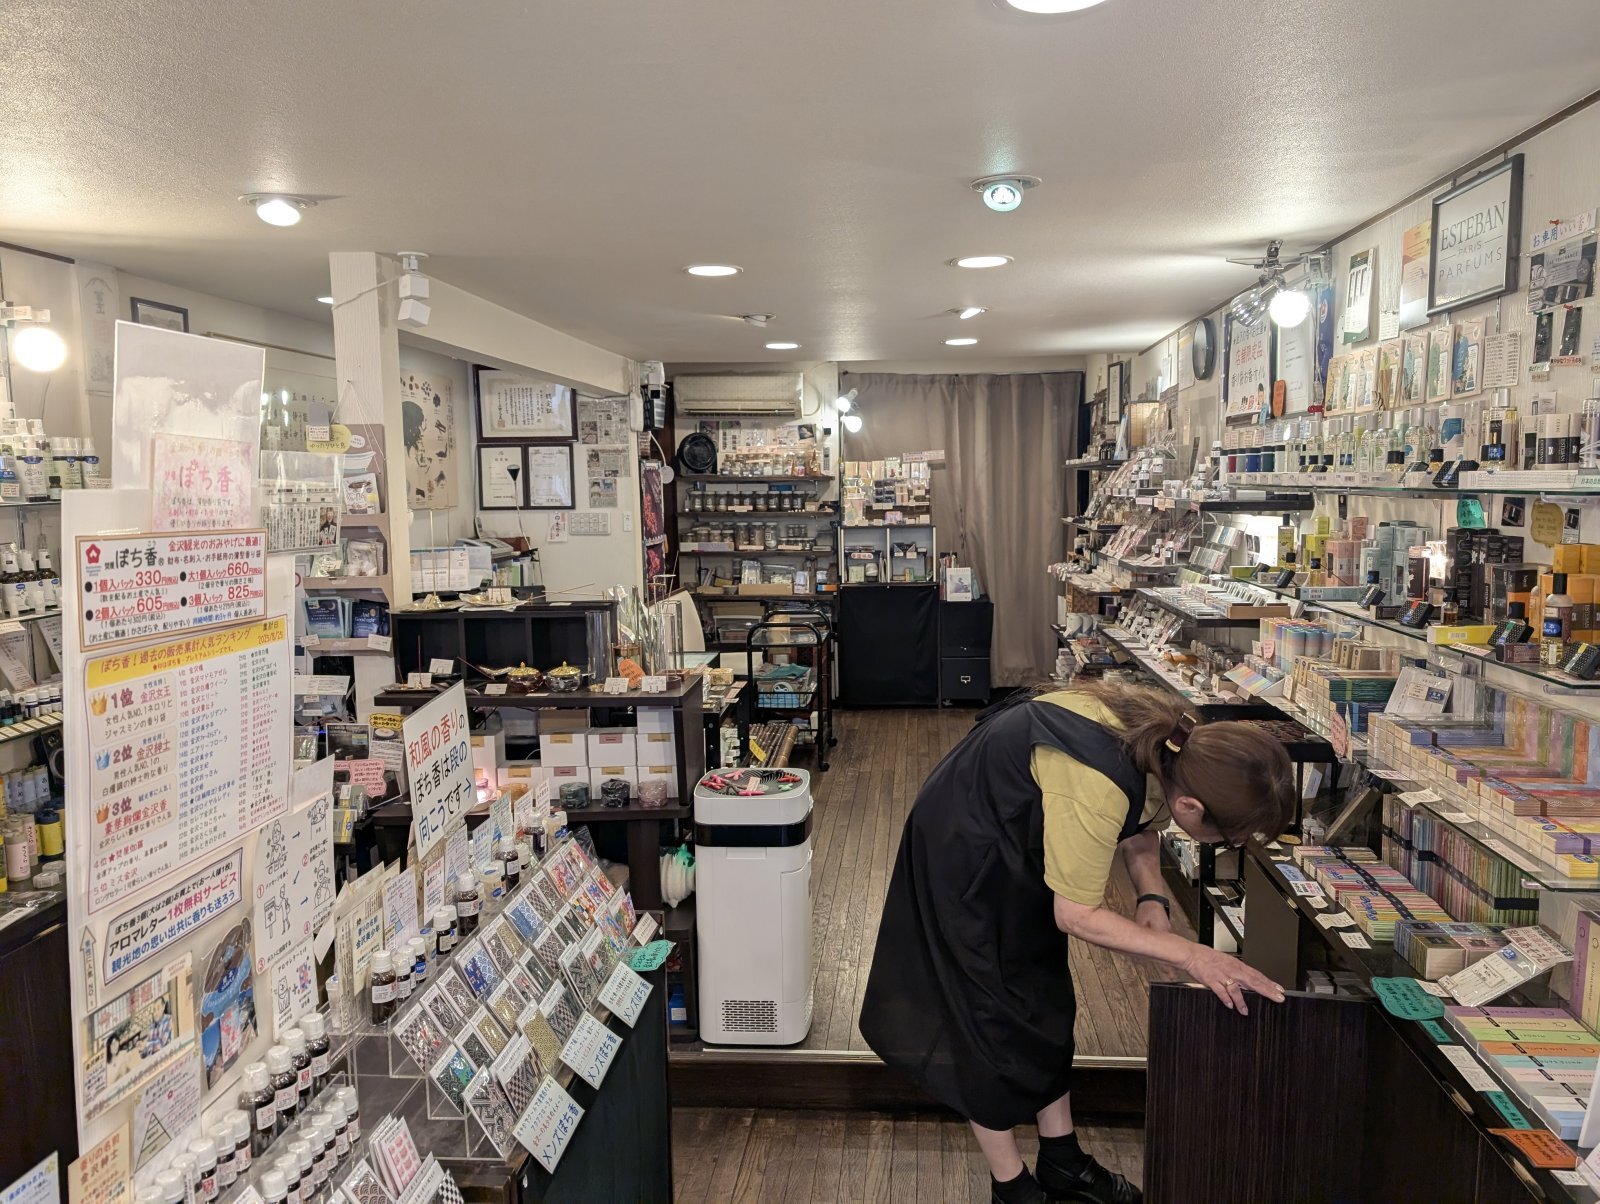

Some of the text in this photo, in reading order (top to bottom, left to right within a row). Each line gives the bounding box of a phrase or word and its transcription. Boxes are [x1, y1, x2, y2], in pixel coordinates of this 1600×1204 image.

[1440, 200, 1506, 252] ESTEBAN
[1458, 240, 1482, 255] PARIS
[1439, 246, 1502, 282] PARFUMS
[115, 547, 158, 569] ぽち香
[111, 687, 135, 709] 1位
[140, 685, 172, 703] 金沢女王
[105, 712, 167, 739] ジャスミンの香り袋
[408, 708, 466, 772] 和風の香りの
[112, 744, 134, 764] 2位
[413, 740, 468, 806] ぽち香は段の
[111, 795, 133, 817] 3位
[418, 782, 463, 849] 向こうです
[587, 1033, 618, 1083] メンズぽち香
[542, 1102, 580, 1165] メンズぽち香
